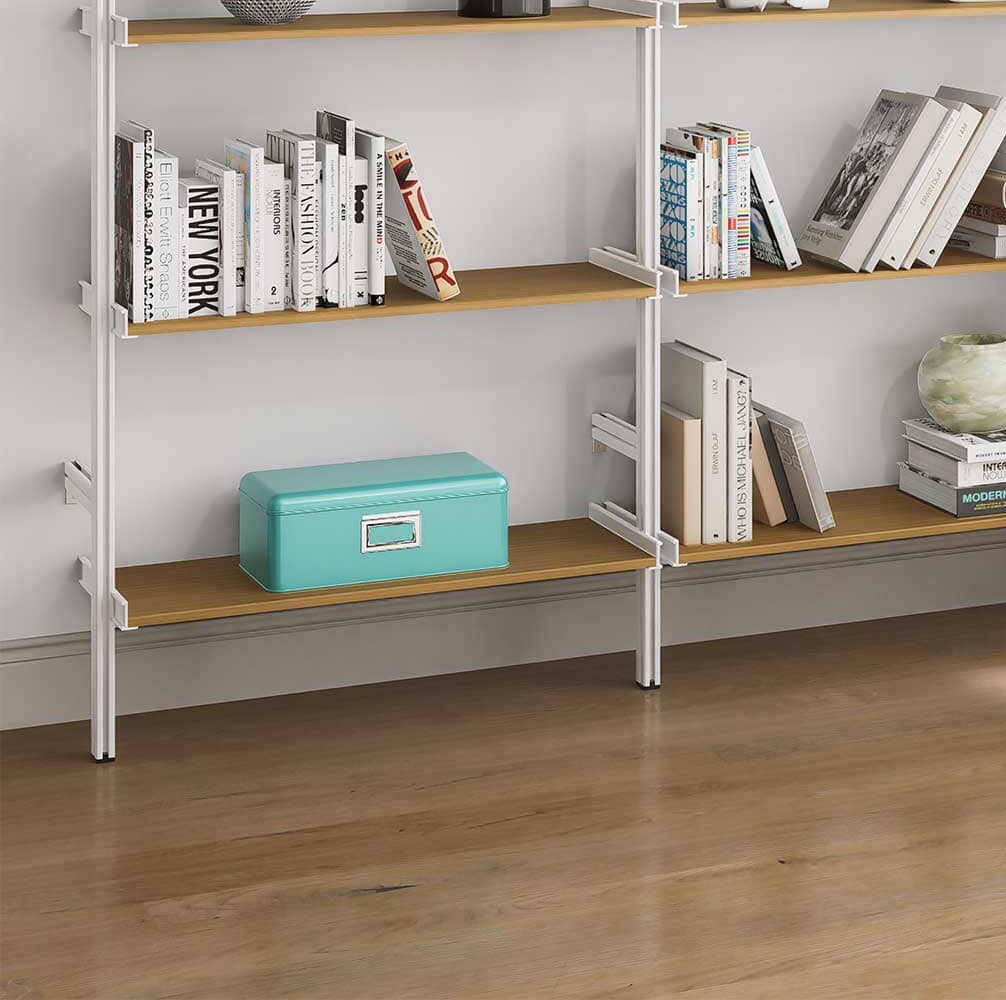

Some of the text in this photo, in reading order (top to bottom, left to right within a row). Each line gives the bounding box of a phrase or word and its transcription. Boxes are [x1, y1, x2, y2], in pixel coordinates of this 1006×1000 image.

[159, 163, 174, 301] Elliott Erwitt Snaps
[188, 187, 219, 315] NEW YORK
[273, 189, 281, 235] INTERIORS
[299, 143, 315, 307] THE FASHION BOOK
[376, 191, 382, 201] IN
[271, 287, 277, 295] 2
[736, 390, 747, 542] WHO IS MICHAEL JANG?
